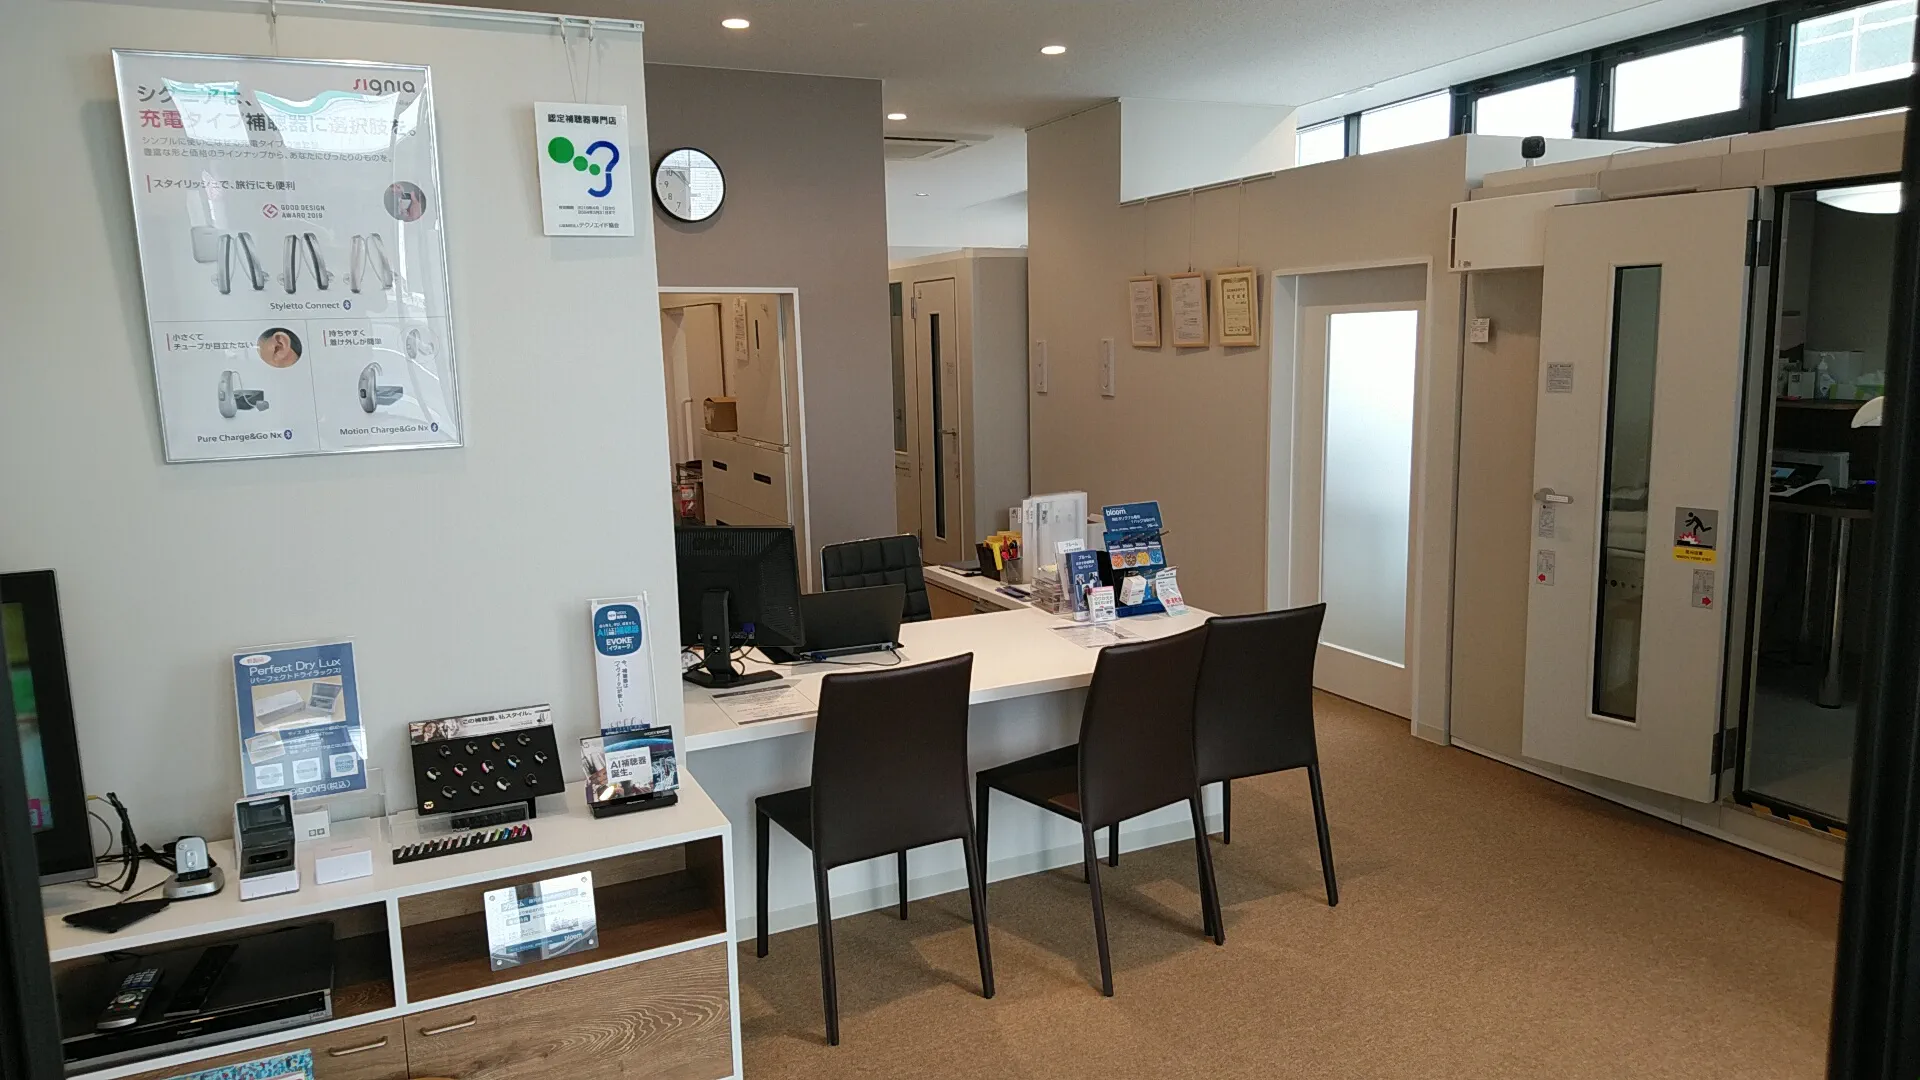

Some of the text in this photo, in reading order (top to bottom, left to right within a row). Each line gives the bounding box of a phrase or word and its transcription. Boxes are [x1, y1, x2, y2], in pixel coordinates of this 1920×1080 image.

[353, 78, 415, 96] signia
[548, 114, 617, 126] 認定補聴器専門店
[664, 180, 669, 188] 9
[281, 203, 326, 211] GOOD DESIGN
[677, 201, 682, 209] 7
[270, 301, 339, 311] Styletto Connect
[340, 424, 429, 436] Motion Charge&Go Nx
[197, 432, 282, 444] Pure Charge&Go Nx
[1105, 507, 1128, 517] bloom
[249, 658, 341, 677] Perfect Dry Lux
[610, 756, 647, 770] AI補聴器
[611, 768, 633, 779] 誕生。
